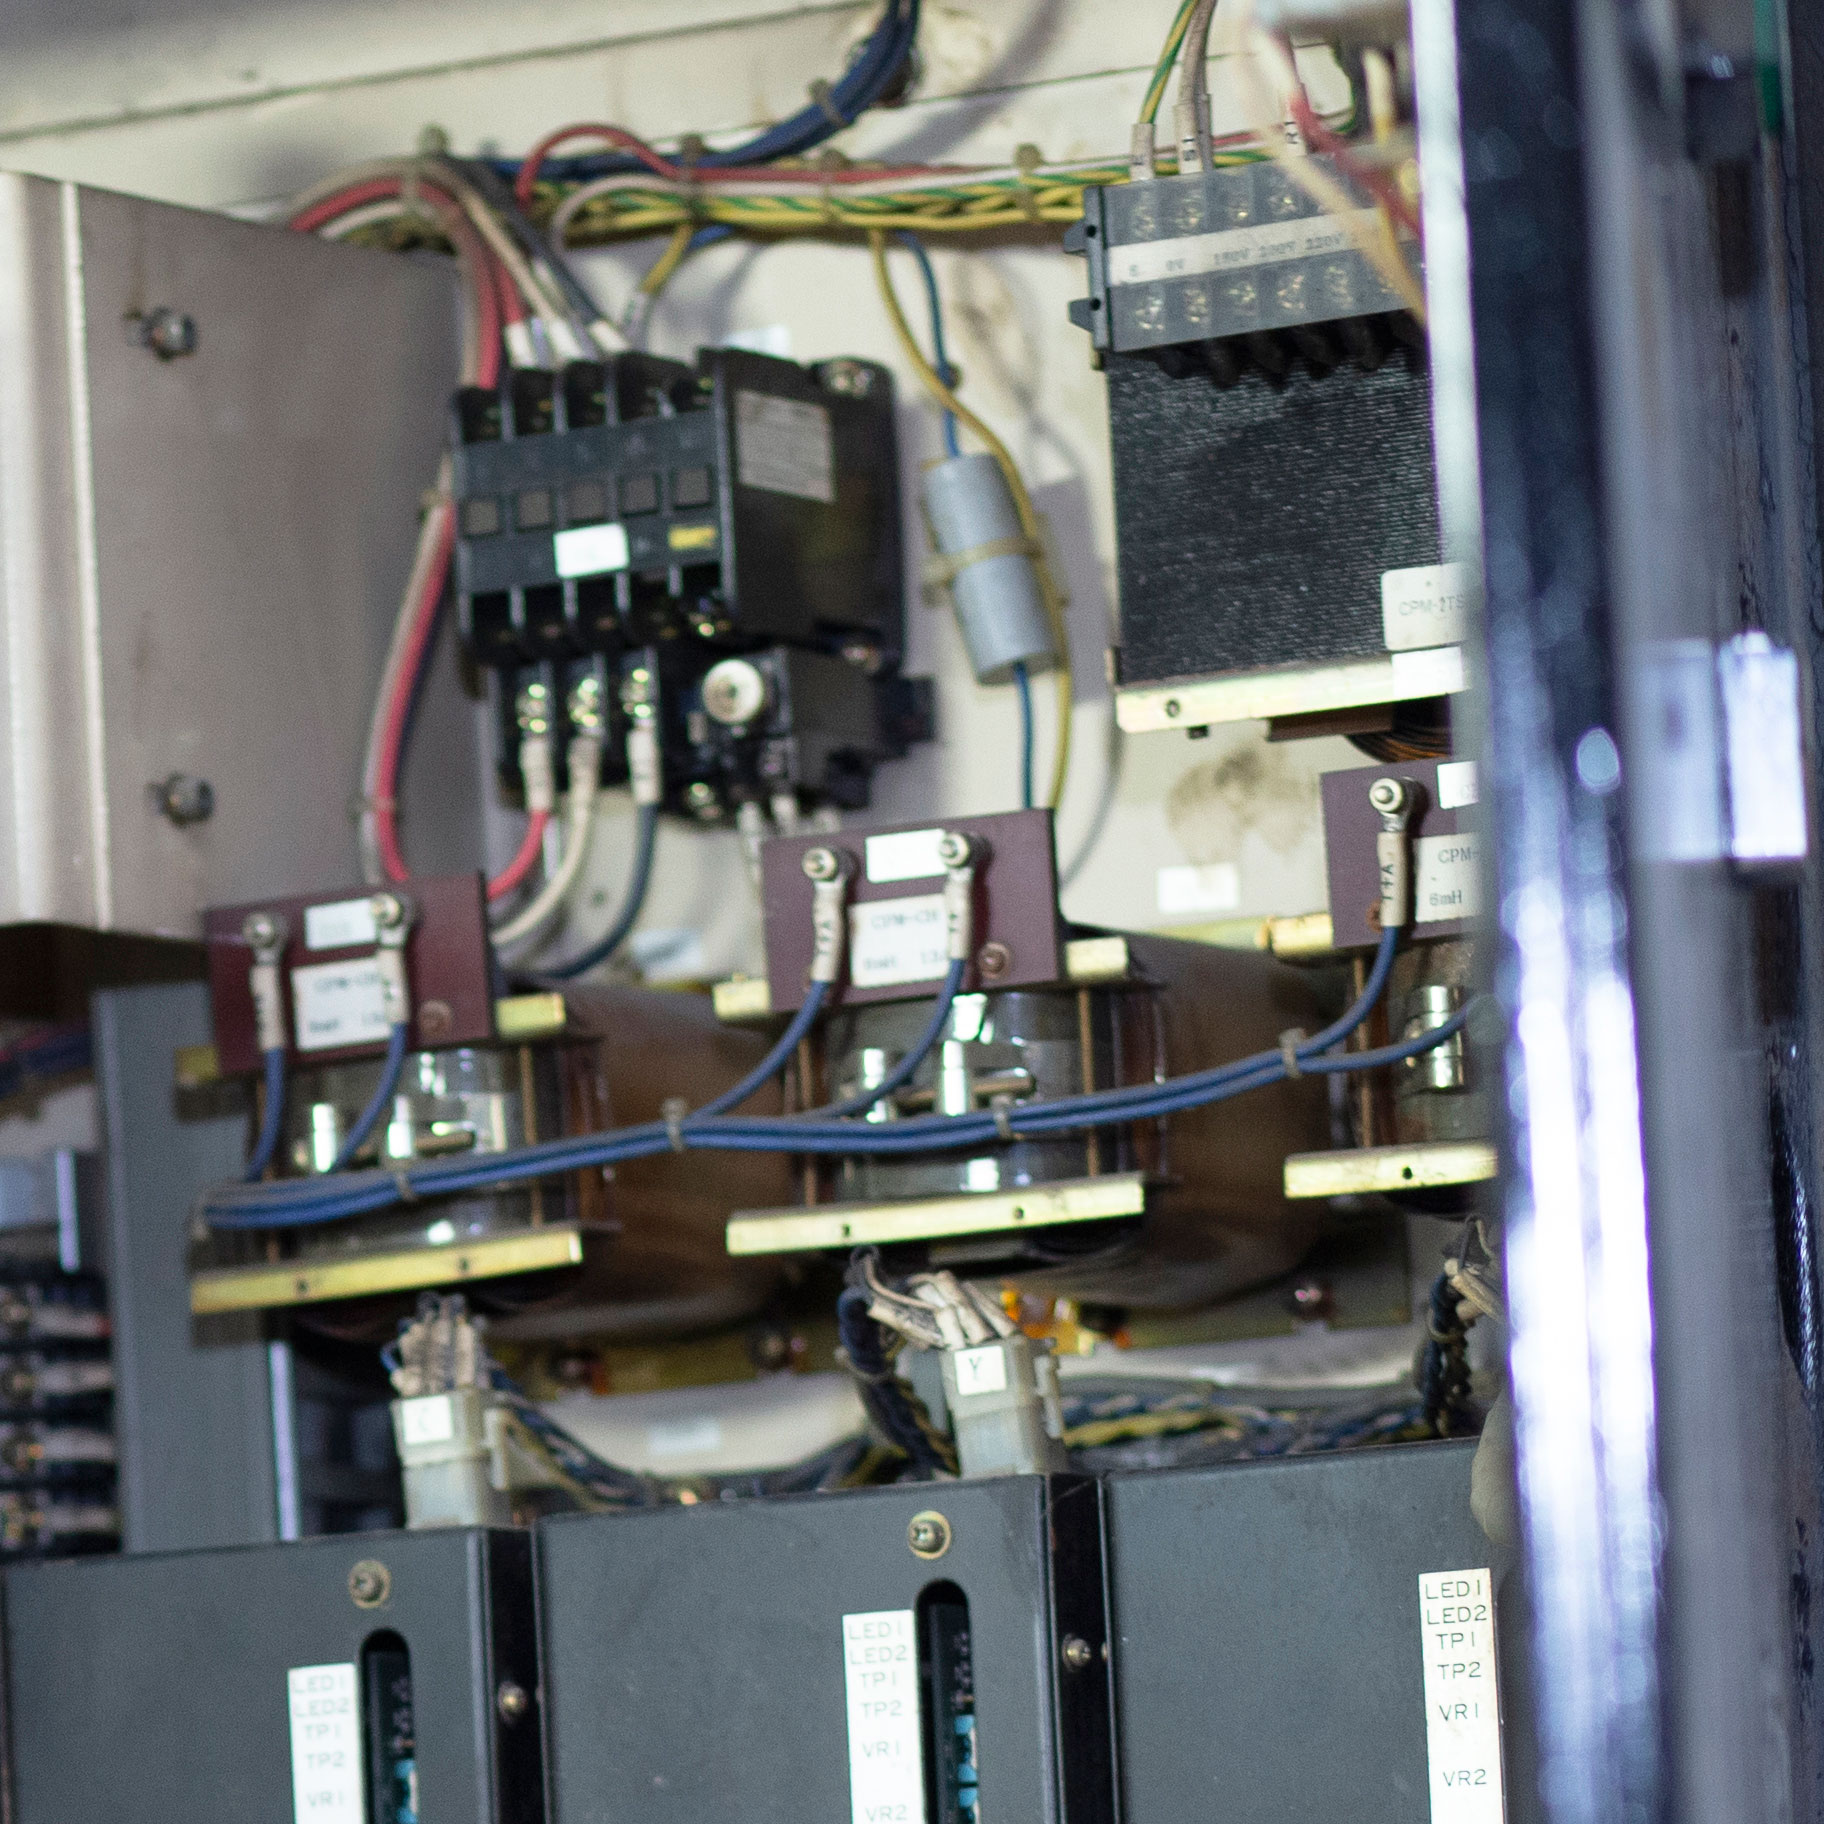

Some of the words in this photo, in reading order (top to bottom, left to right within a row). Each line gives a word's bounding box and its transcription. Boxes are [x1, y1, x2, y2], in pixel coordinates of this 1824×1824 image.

[1425, 1579, 1481, 1599] LED1
[1426, 1604, 1488, 1625] LED2
[849, 1620, 902, 1640] LED1
[1435, 1631, 1475, 1650] TP1
[851, 1645, 907, 1665] LED2
[859, 1671, 897, 1688] TP1
[1437, 1661, 1482, 1680] TP2
[861, 1700, 902, 1719] TP2
[1439, 1702, 1479, 1721] VR1
[862, 1741, 900, 1758] VR1
[1443, 1768, 1487, 1787] VR2
[865, 1804, 908, 1822] VR2
